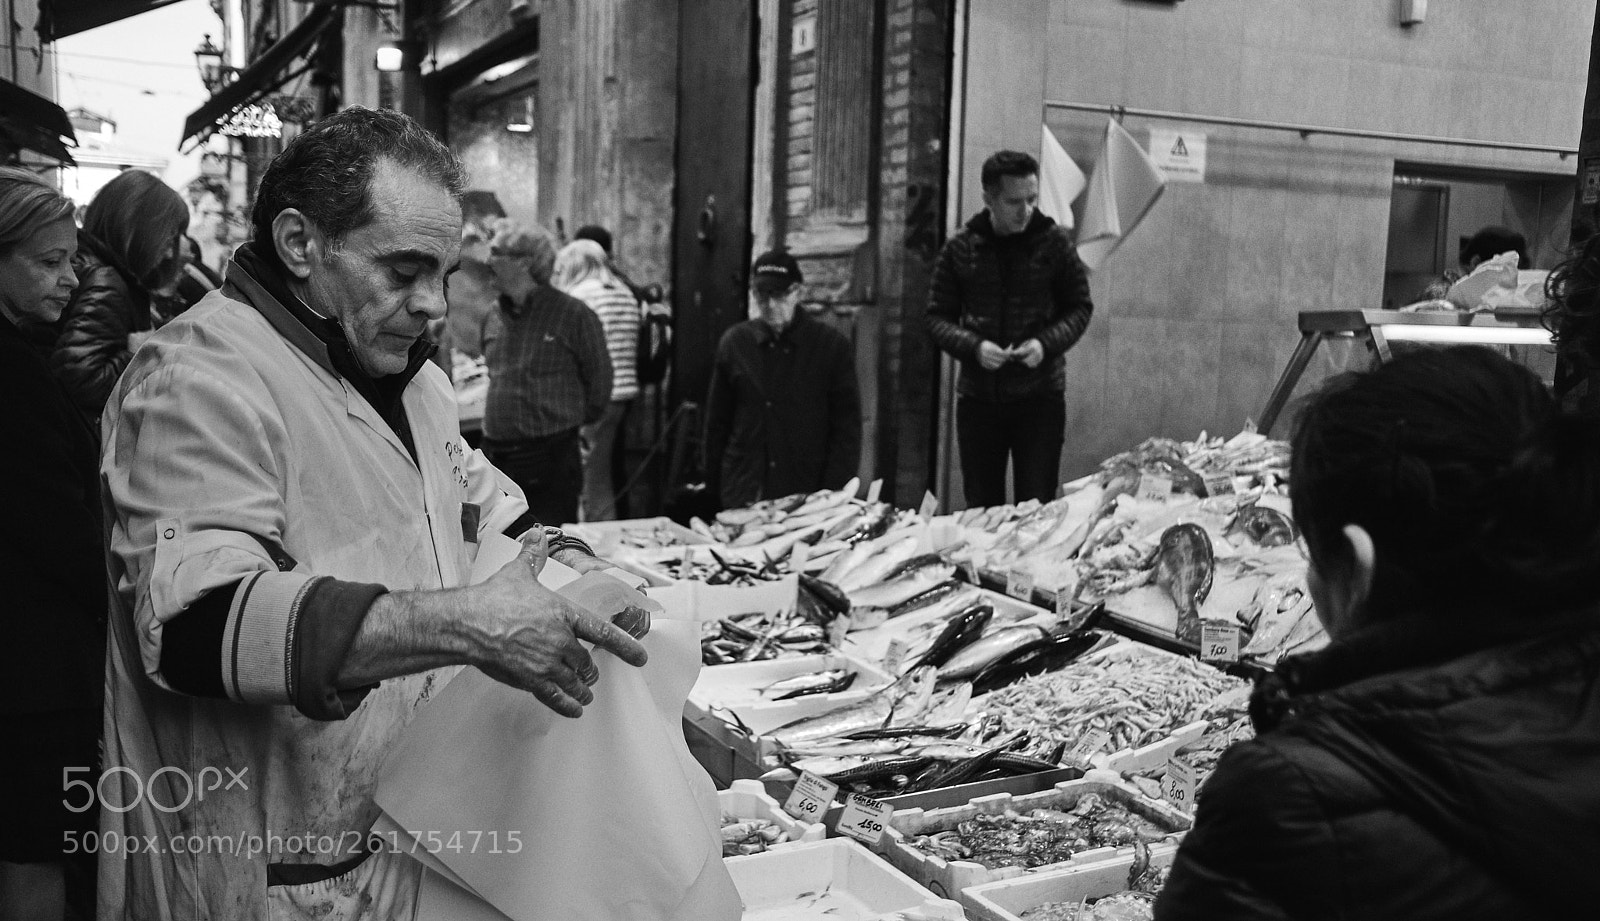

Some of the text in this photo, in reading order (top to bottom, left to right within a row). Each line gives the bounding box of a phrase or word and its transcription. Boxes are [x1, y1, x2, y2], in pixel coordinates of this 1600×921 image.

[1210, 644, 1227, 657] 7,00
[1170, 780, 1185, 801] 8,00
[798, 798, 818, 813] 6,00
[857, 819, 882, 833] 15,00
